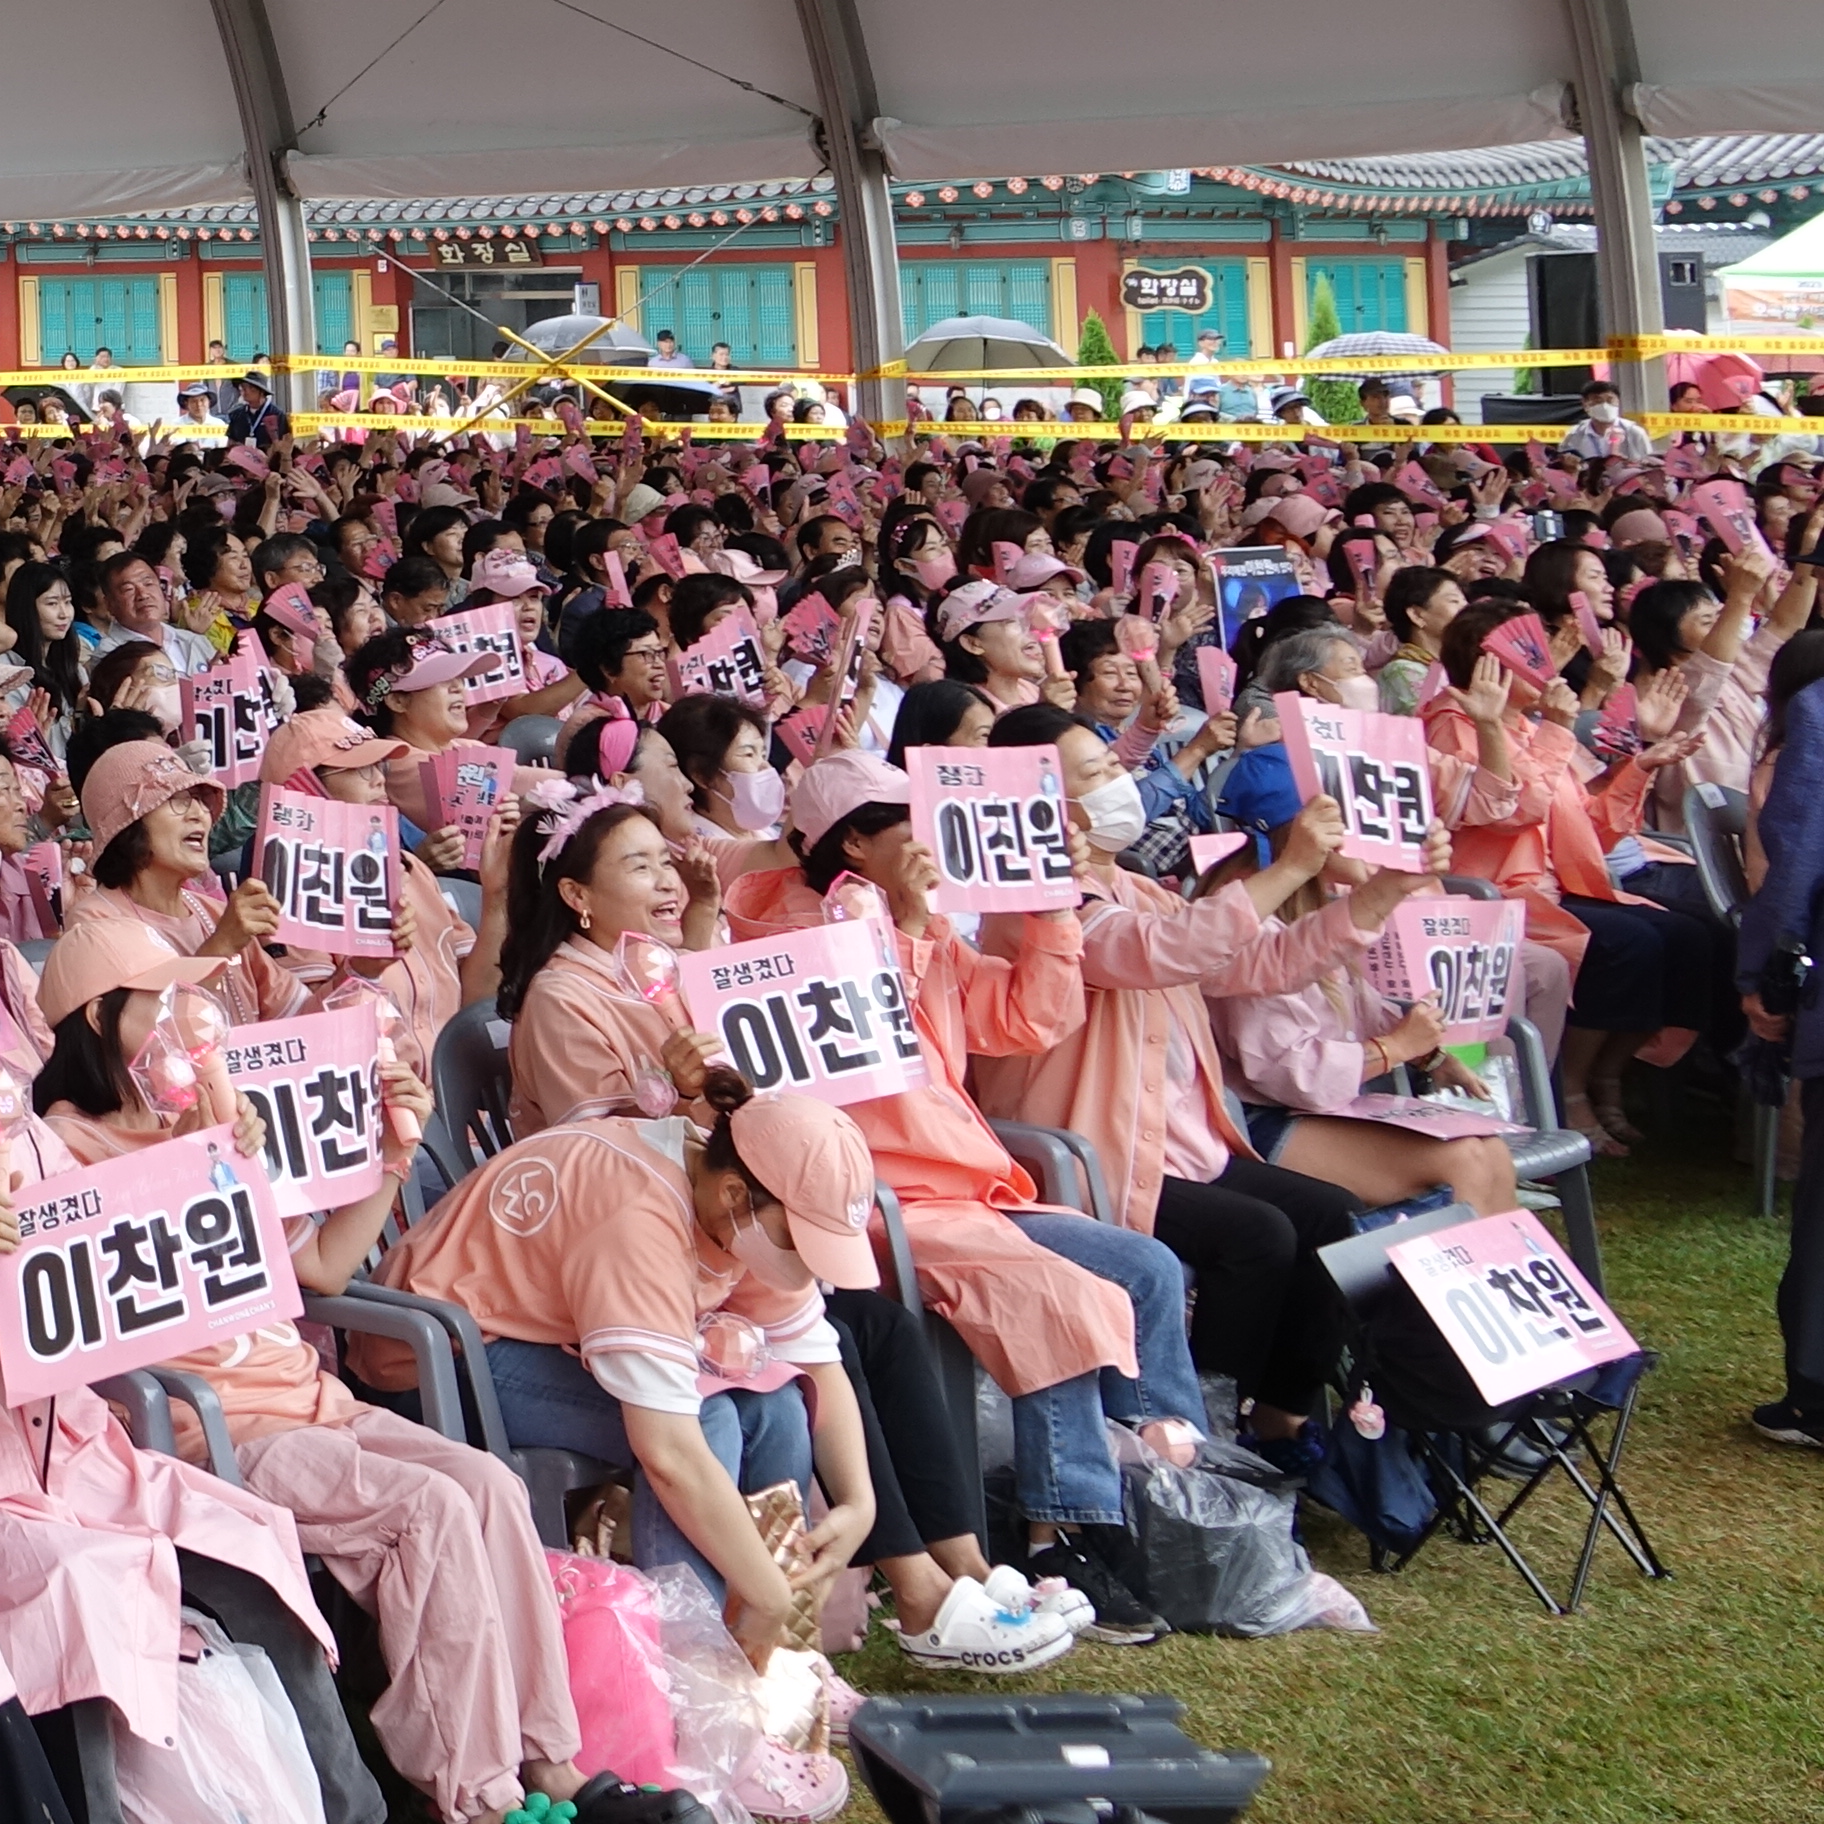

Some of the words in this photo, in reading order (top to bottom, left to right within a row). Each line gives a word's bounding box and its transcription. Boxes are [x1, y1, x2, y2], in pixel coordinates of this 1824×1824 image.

[438, 241, 532, 265] 화장실
[1140, 278, 1197, 296] 화장실
[711, 953, 796, 991] 잘생겼다
[721, 972, 923, 1090] 이찬원
[225, 1037, 308, 1075] 잘생겼다
[17, 1188, 103, 1237] 잘생겼다
[21, 1188, 270, 1357] 이찬원
[1446, 1257, 1609, 1366] 이찬원
[960, 1648, 1026, 1667] crocs
